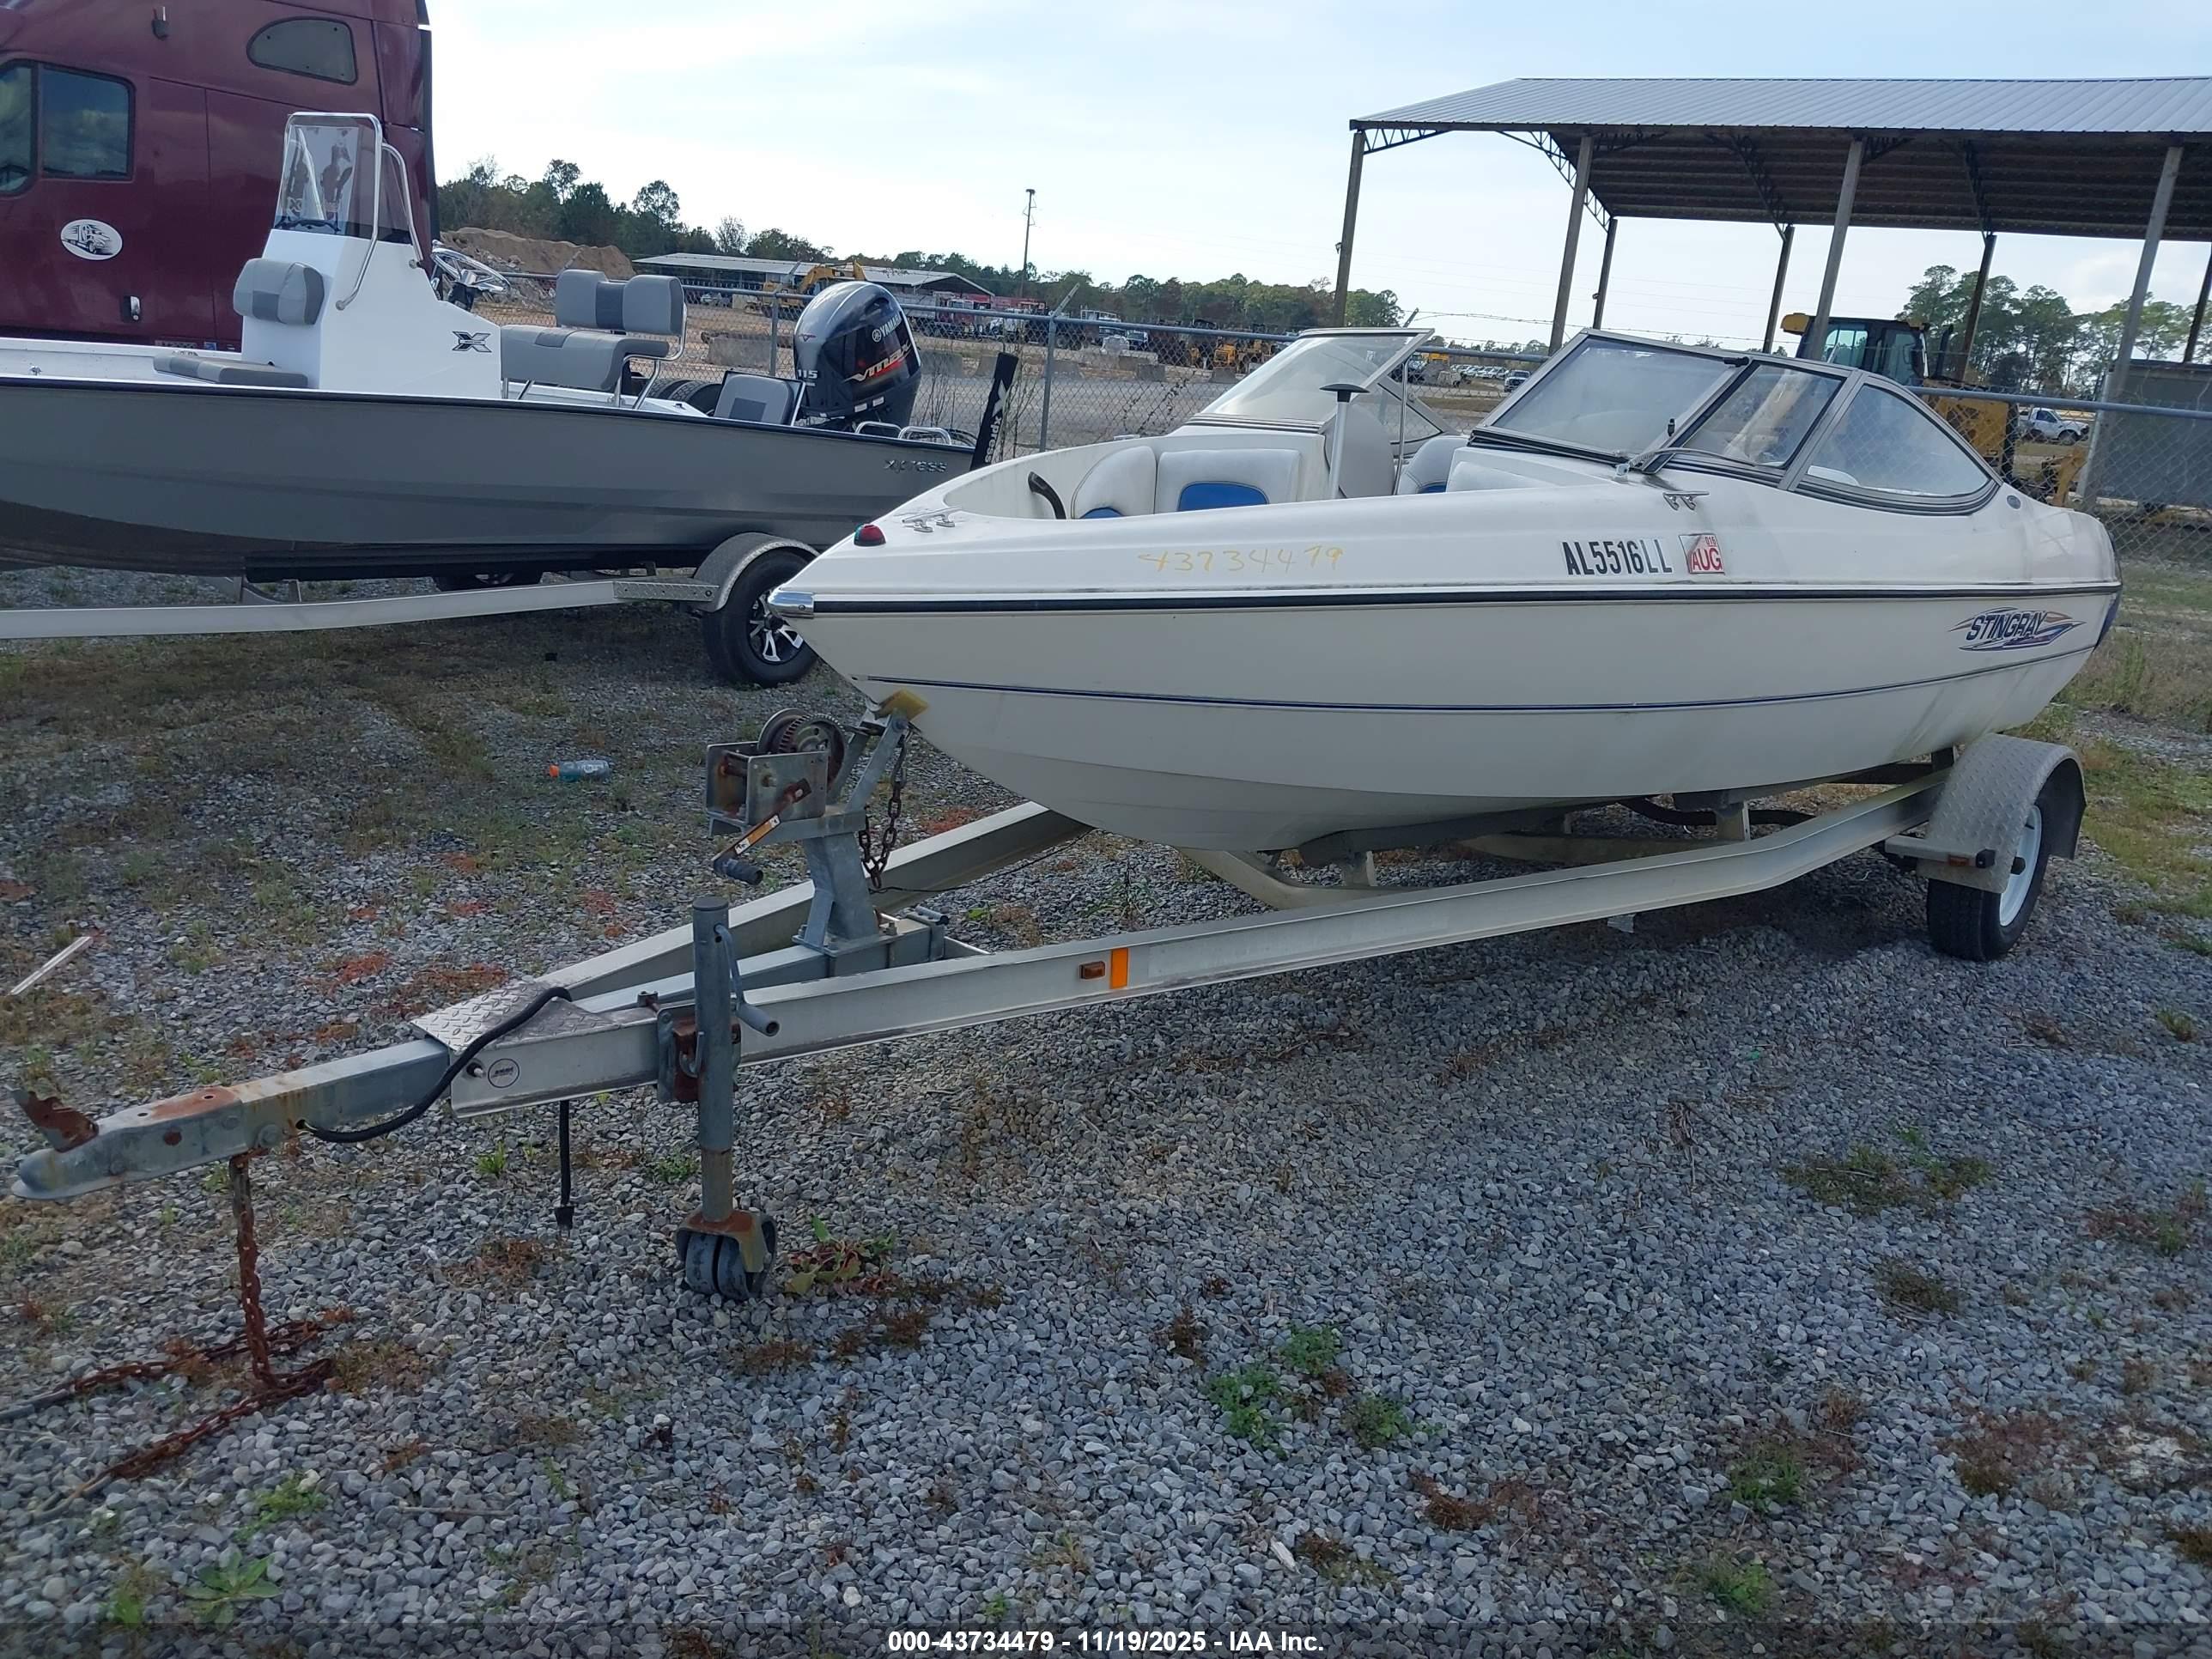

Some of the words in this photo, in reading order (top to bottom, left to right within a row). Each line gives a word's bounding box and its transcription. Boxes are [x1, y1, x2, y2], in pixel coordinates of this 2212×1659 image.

[797, 369, 818, 379] 115
[1562, 539, 1674, 575] AL5516LL
[1691, 548, 1723, 571] AUG
[1966, 611, 2048, 641] STINGRAY
